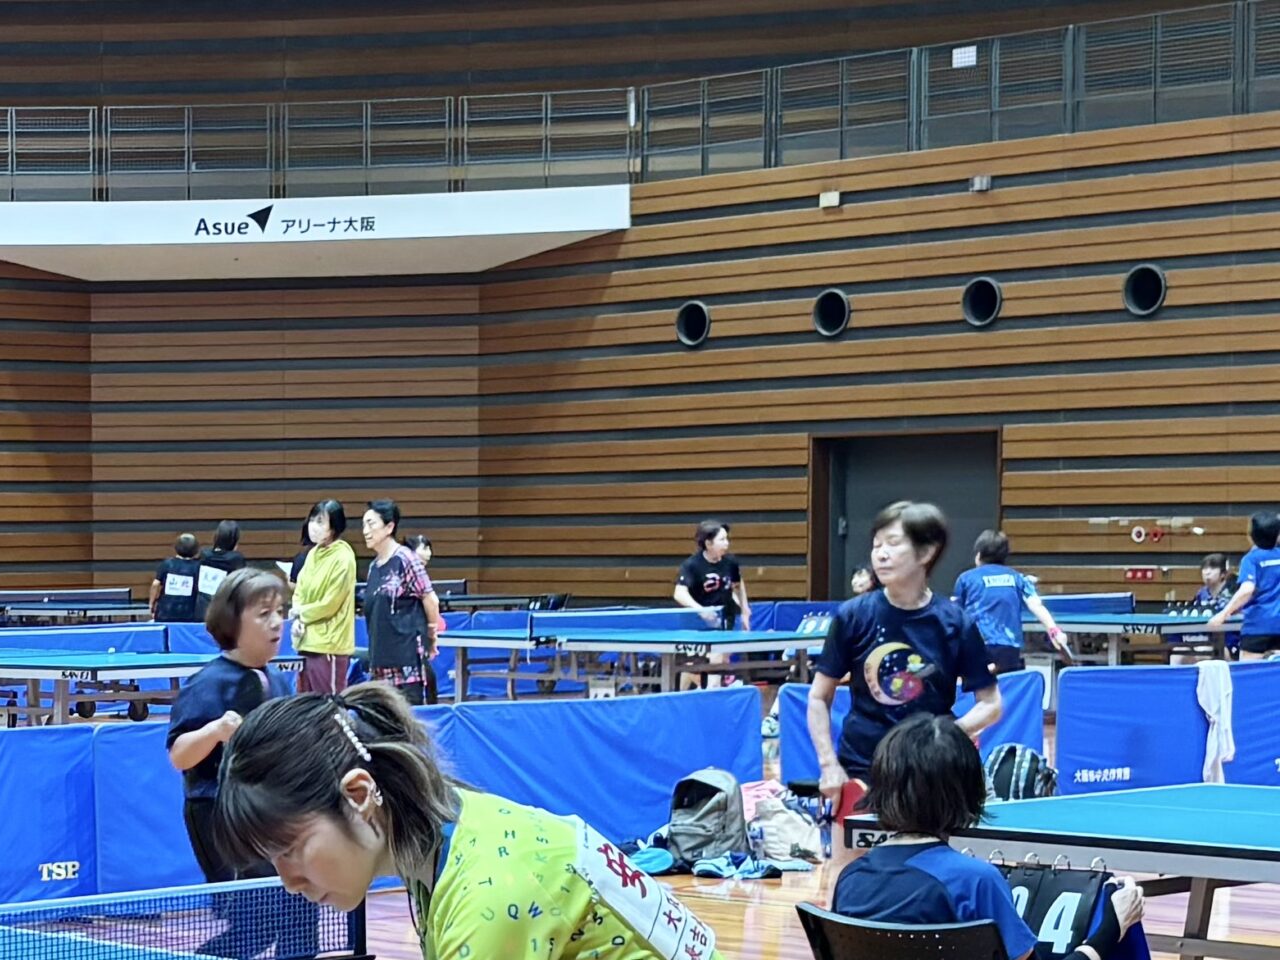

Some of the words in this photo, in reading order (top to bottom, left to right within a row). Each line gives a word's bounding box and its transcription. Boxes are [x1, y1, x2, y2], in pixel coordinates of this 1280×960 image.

[194, 217, 249, 236] Asue
[280, 215, 376, 234] アリーナ大阪
[498, 846, 510, 858] R
[38, 861, 80, 881] TSP
[507, 903, 519, 920] Q
[528, 900, 544, 919] W
[1038, 891, 1082, 954] 4
